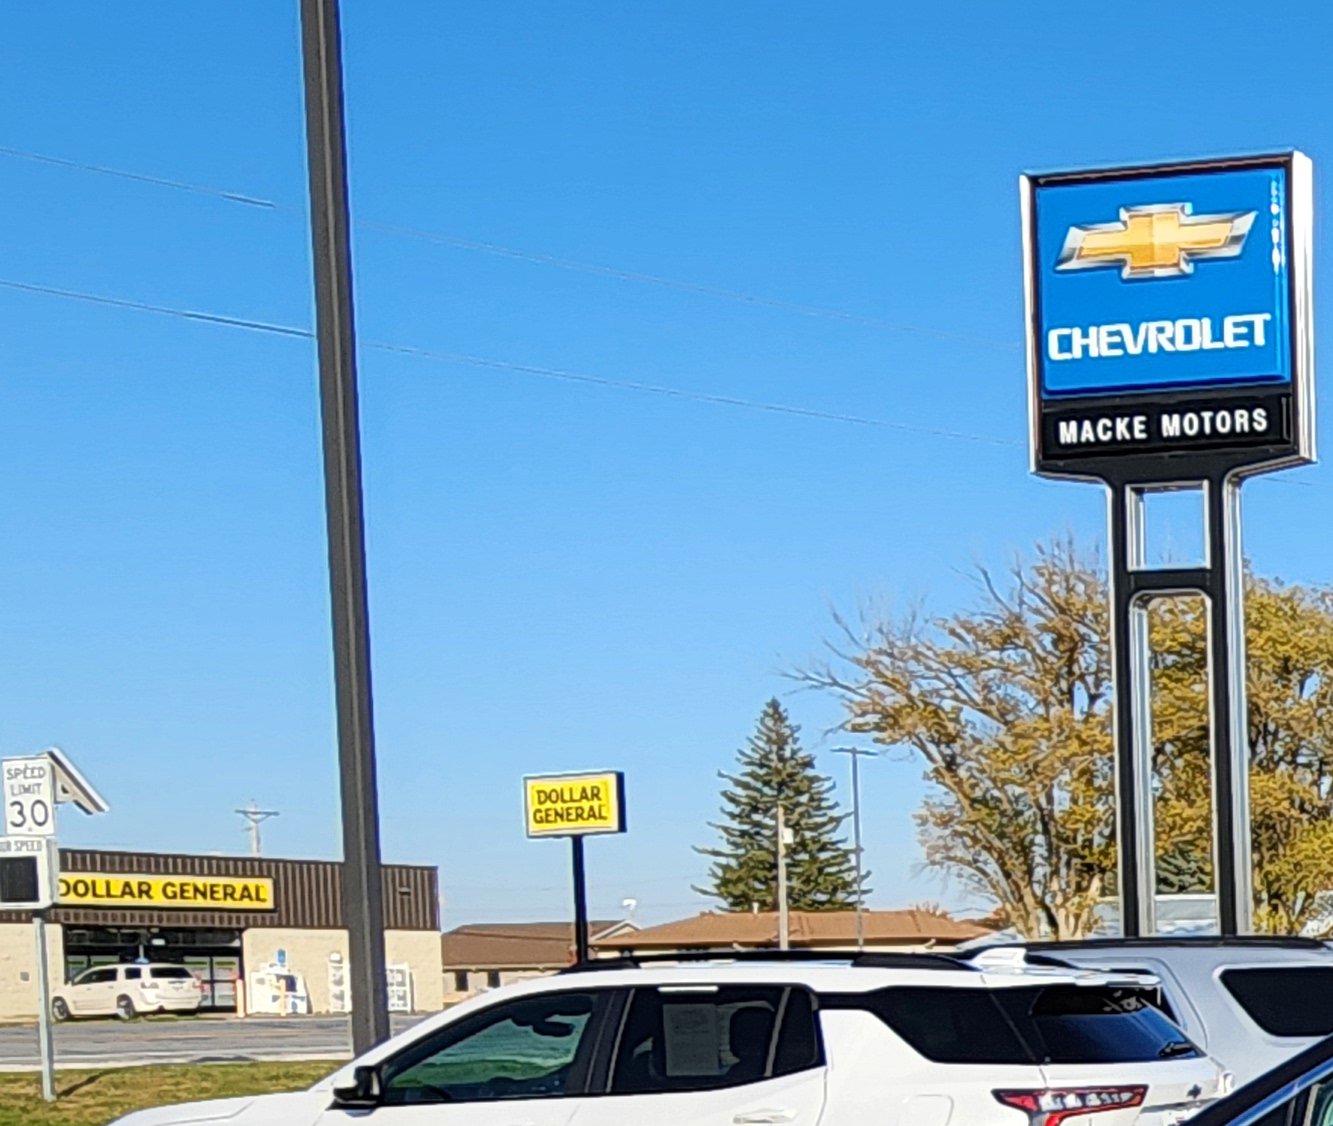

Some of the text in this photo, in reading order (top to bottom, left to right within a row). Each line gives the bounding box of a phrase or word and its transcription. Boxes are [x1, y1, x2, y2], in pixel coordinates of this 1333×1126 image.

[1047, 313, 1271, 361] CHEVROLET
[1058, 408, 1268, 445] MACKE MOTORS
[6, 764, 46, 780] SPEED
[10, 783, 42, 797] LIMIT
[535, 785, 602, 806] DOLLAR
[9, 799, 49, 828] 30
[532, 804, 608, 824] GENERAL
[58, 878, 268, 903] DOLLAR GENERAL
